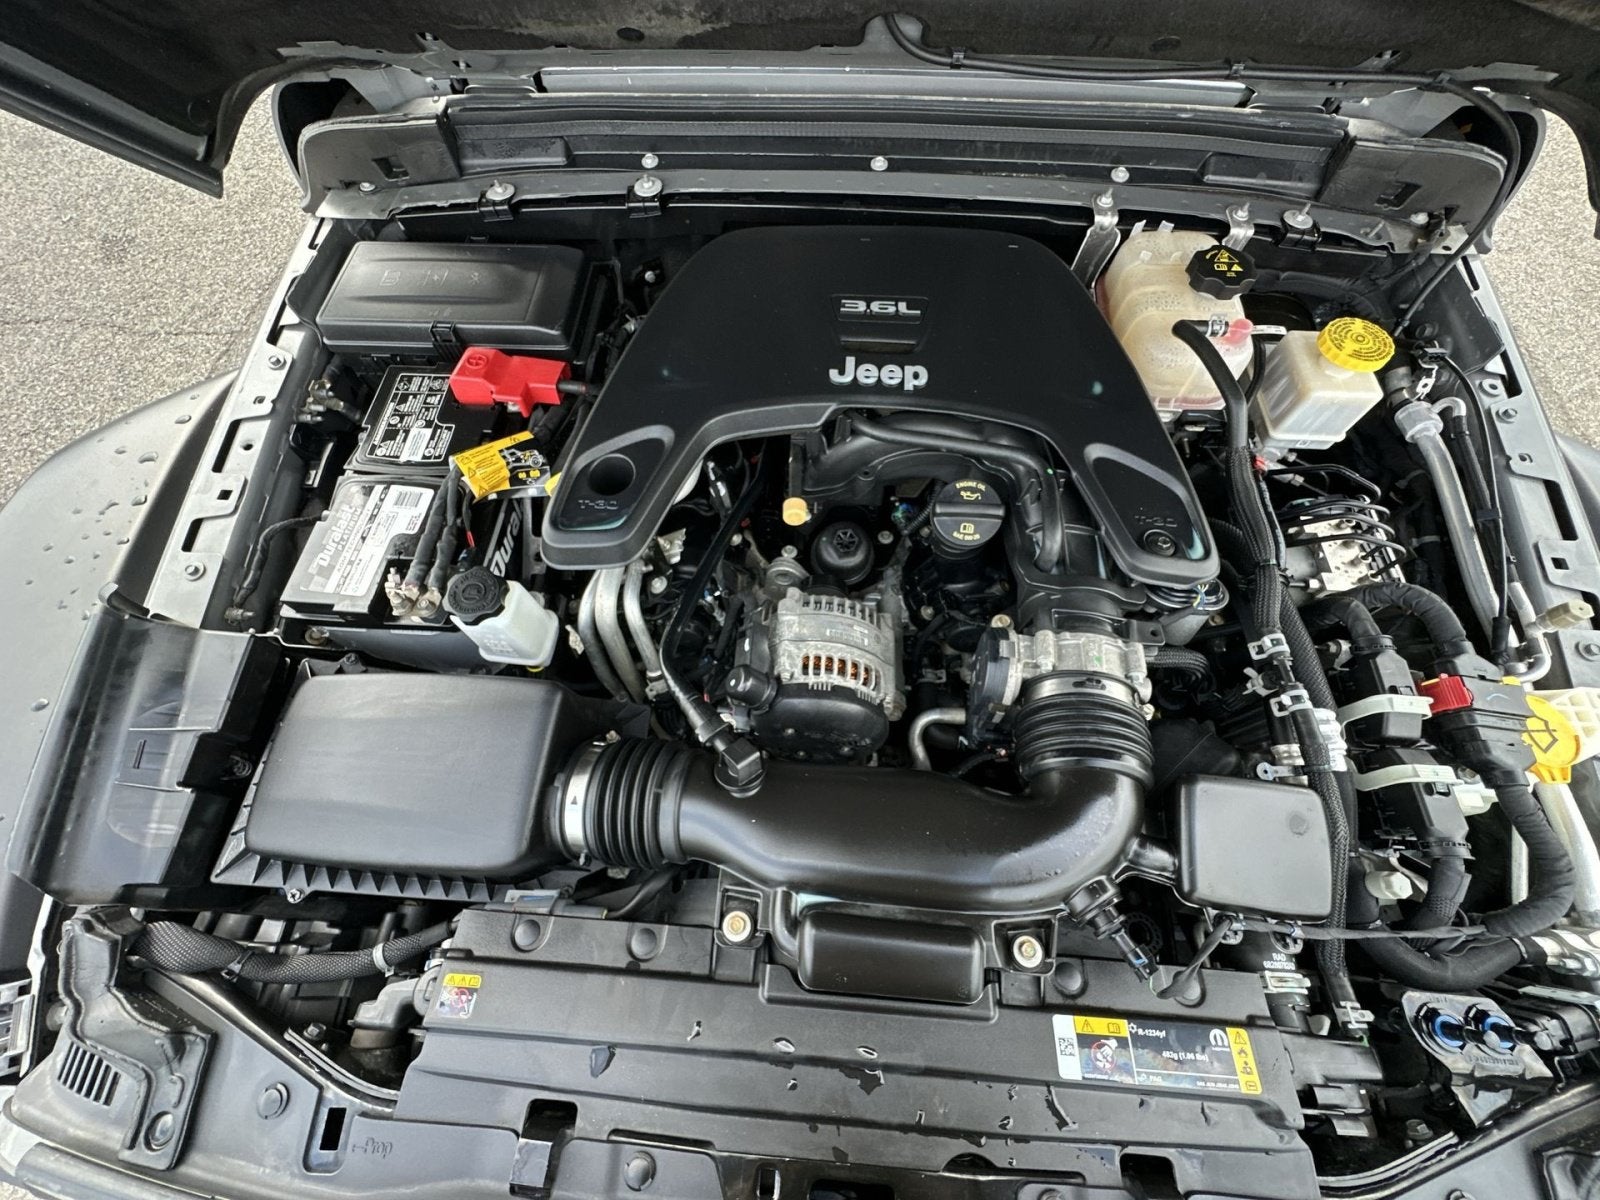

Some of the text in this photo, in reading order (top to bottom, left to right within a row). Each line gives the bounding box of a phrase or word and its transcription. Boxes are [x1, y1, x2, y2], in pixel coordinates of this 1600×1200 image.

[840, 299, 921, 316] 3.6L
[828, 356, 929, 392] Jeep
[955, 481, 986, 491] ENGINE OIL
[578, 500, 618, 510] T-30
[337, 507, 362, 551] PLATINUM
[1134, 515, 1178, 528] T-30
[315, 502, 357, 568] Duralast
[490, 499, 523, 578] Dural
[1272, 952, 1287, 961] RAD
[1137, 1028, 1166, 1039] R-1234yf
